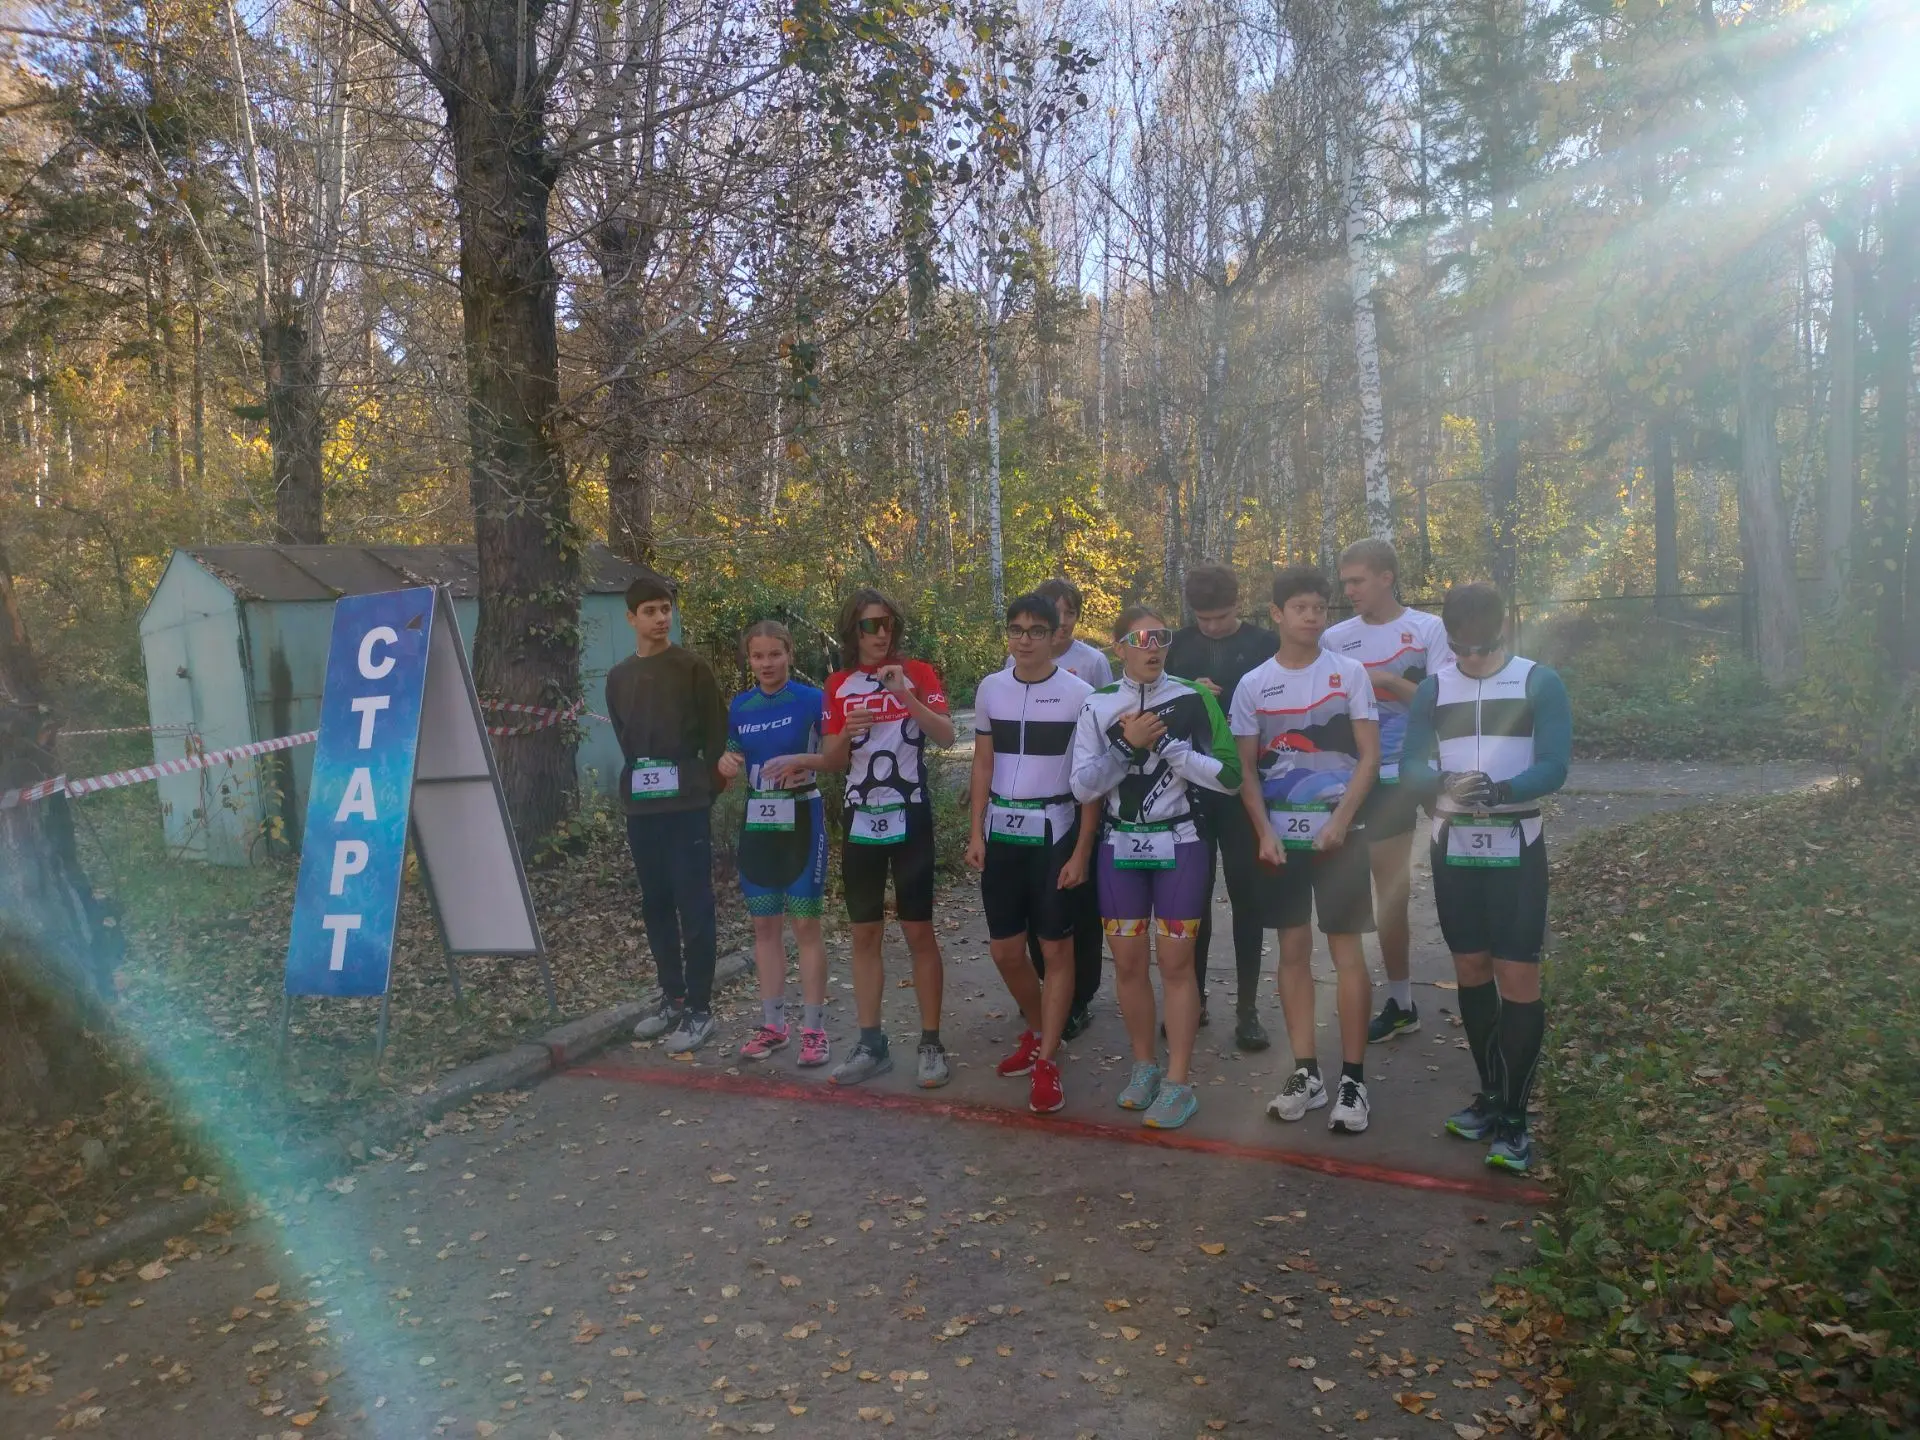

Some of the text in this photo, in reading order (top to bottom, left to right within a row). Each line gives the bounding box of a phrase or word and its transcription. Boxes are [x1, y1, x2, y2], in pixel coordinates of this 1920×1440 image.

[642, 772, 660, 786] 33
[322, 625, 399, 971] СТАРТ
[759, 804, 776, 818] 23
[871, 818, 889, 833] 28
[1006, 814, 1025, 829] 27
[1286, 817, 1311, 833] 26
[1131, 838, 1155, 853] 24
[1471, 833, 1493, 849] 31
